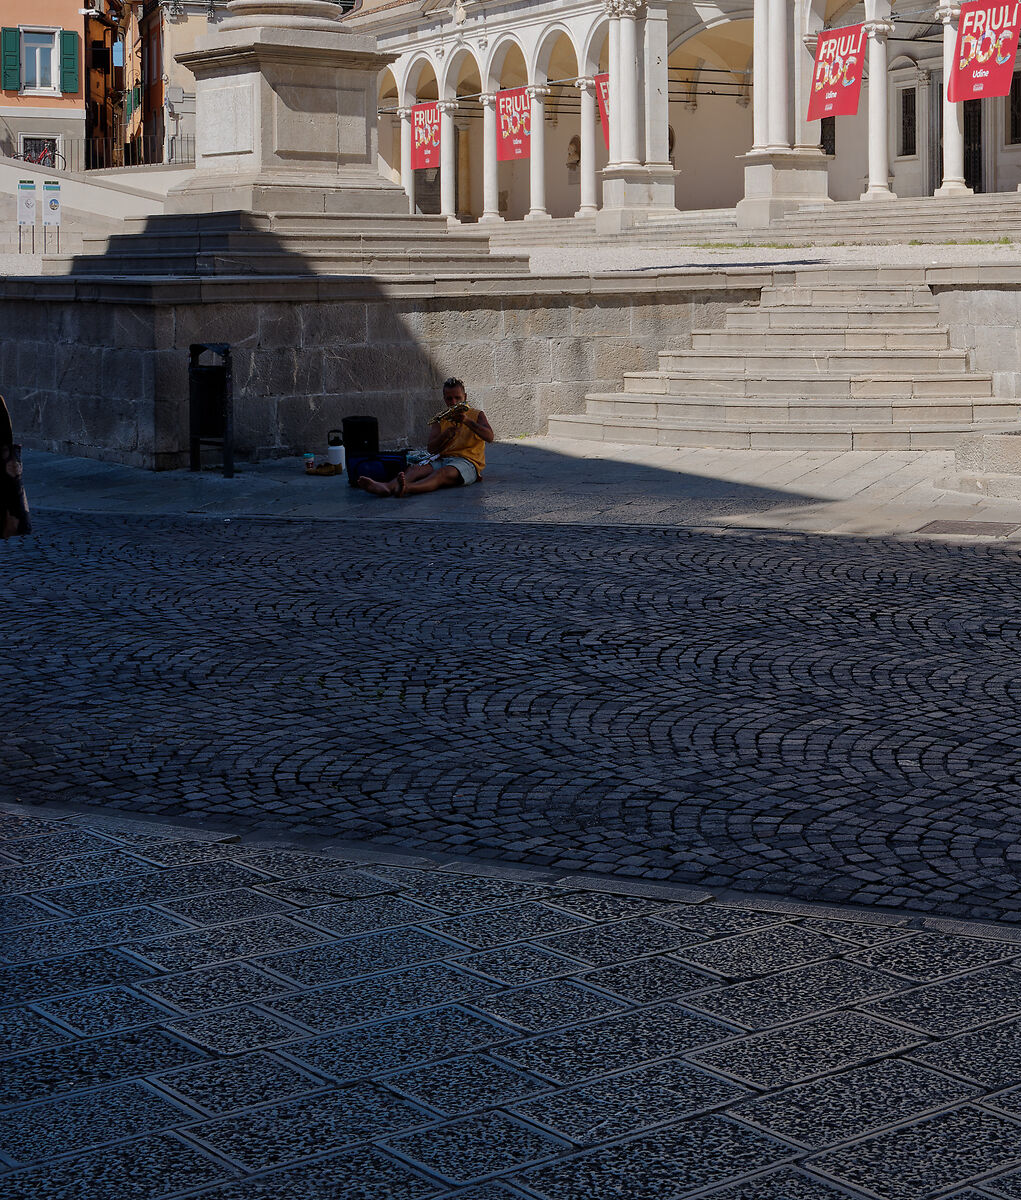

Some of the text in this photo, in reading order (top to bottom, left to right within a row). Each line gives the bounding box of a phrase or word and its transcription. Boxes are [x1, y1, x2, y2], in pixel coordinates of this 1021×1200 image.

[963, 3, 1019, 35] FRIULI
[819, 32, 863, 60] FRIULI
[960, 29, 1013, 70] DOC
[815, 55, 857, 92] DOC
[414, 108, 440, 126] FRIULI
[500, 94, 530, 114] FRIULI
[415, 124, 440, 149] DOC
[501, 111, 531, 139] DOC
